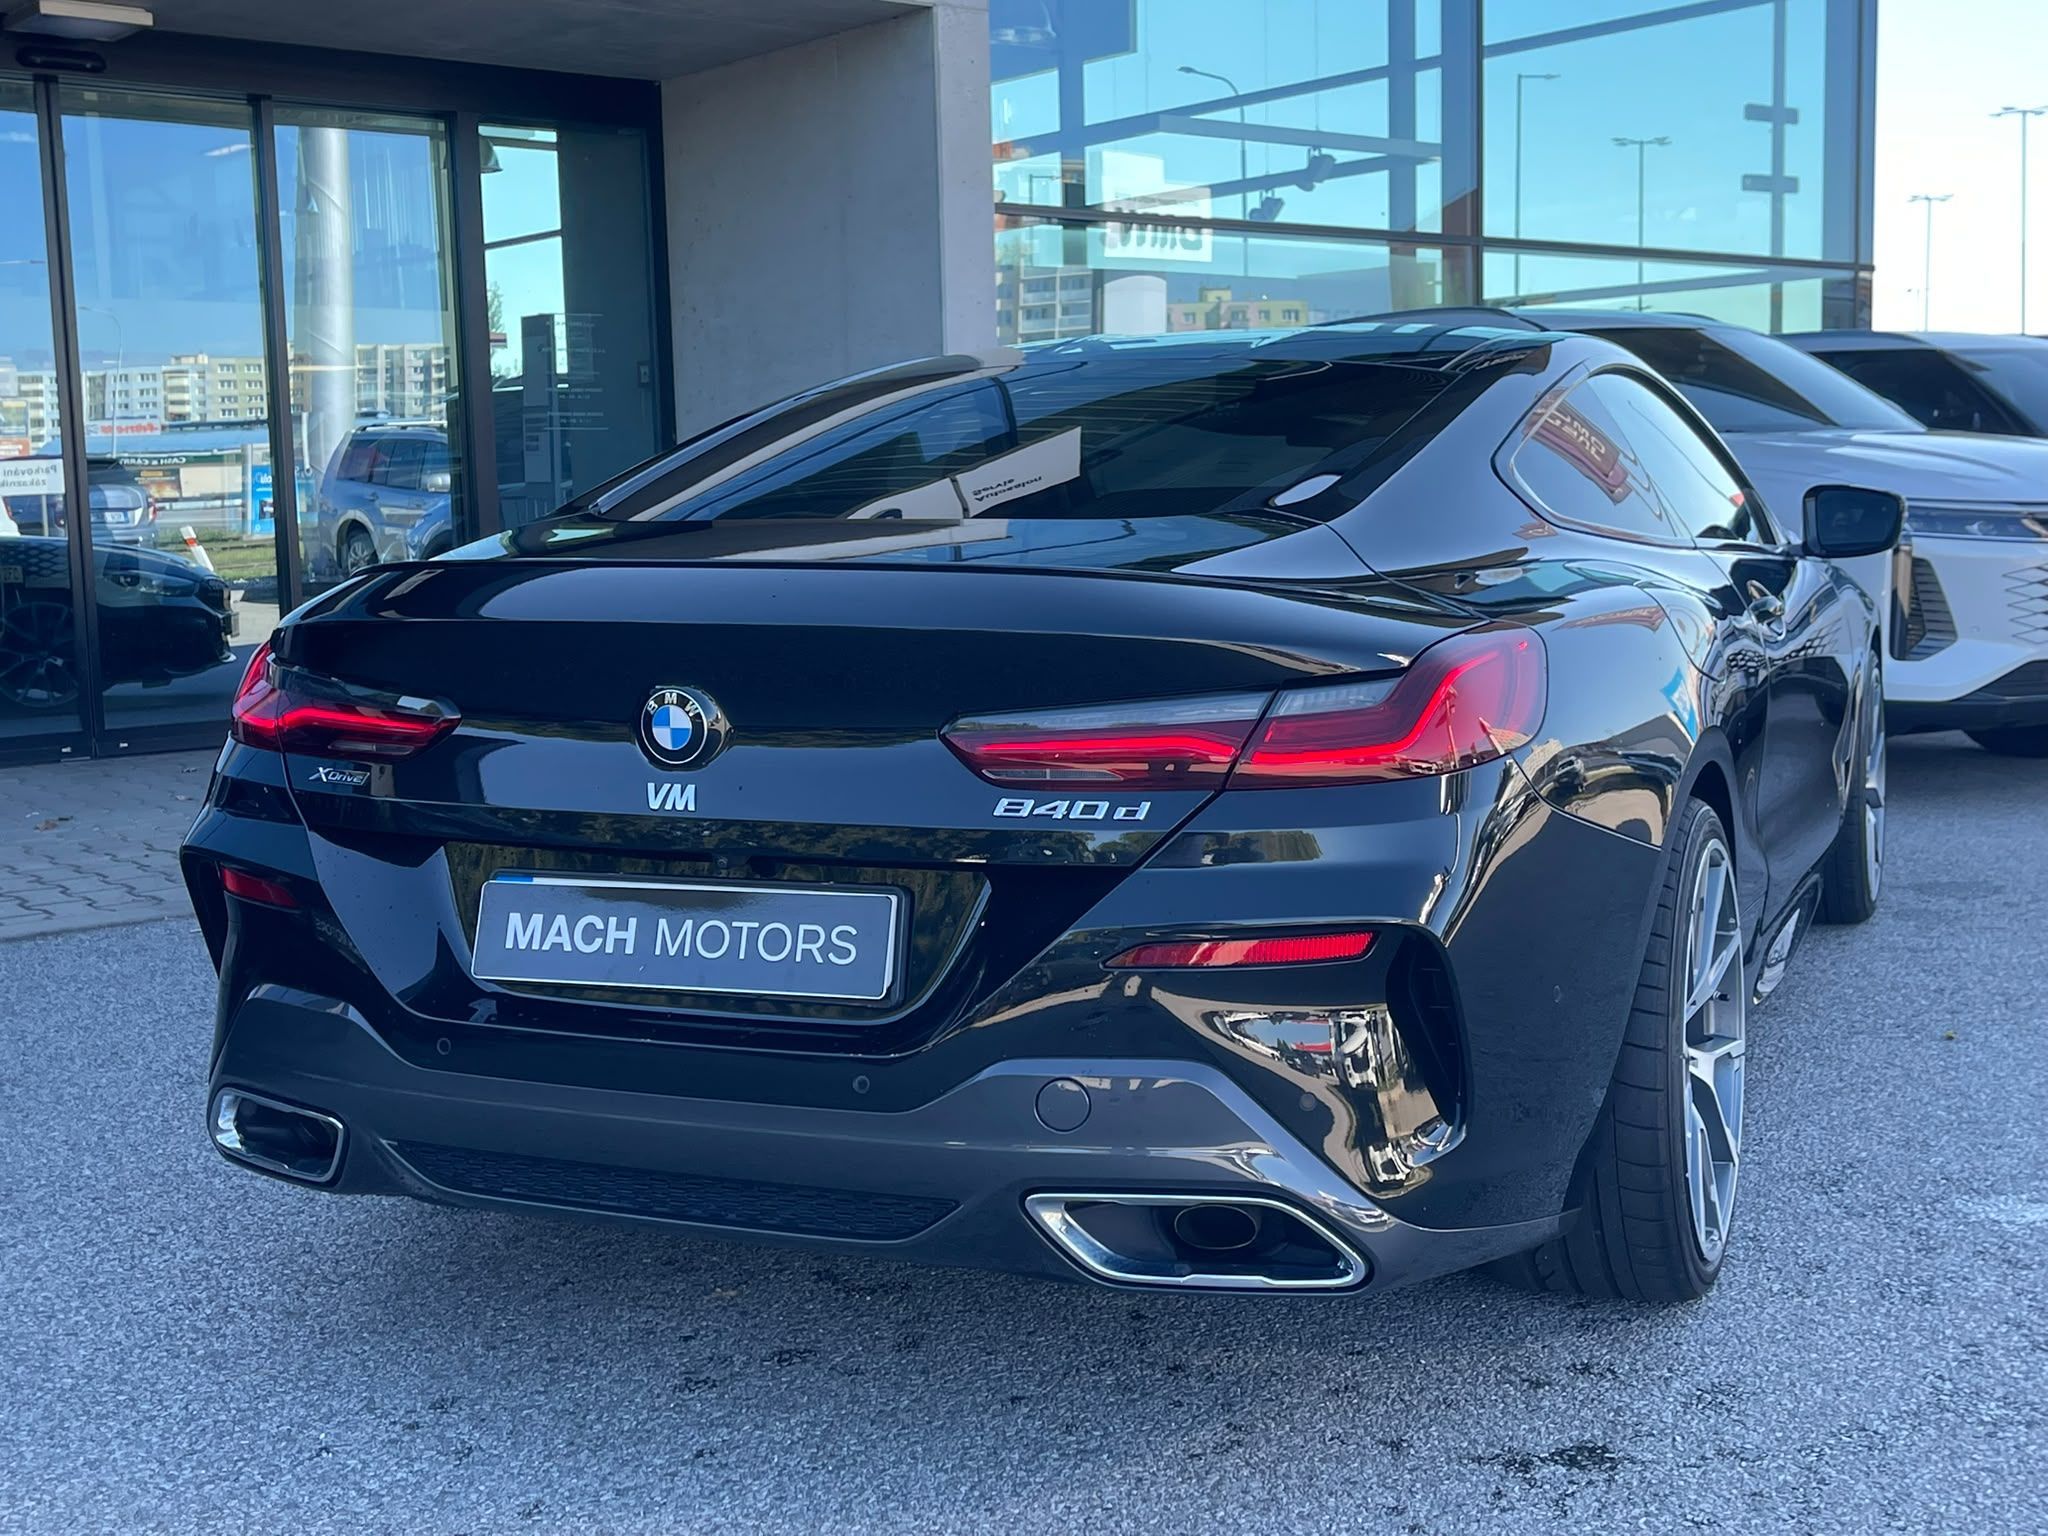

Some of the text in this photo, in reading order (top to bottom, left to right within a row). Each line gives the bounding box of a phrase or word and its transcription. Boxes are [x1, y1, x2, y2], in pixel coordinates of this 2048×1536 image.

[647, 692, 700, 717] BMW
[646, 782, 697, 812] VM
[504, 911, 860, 967] MACH MOTORS
